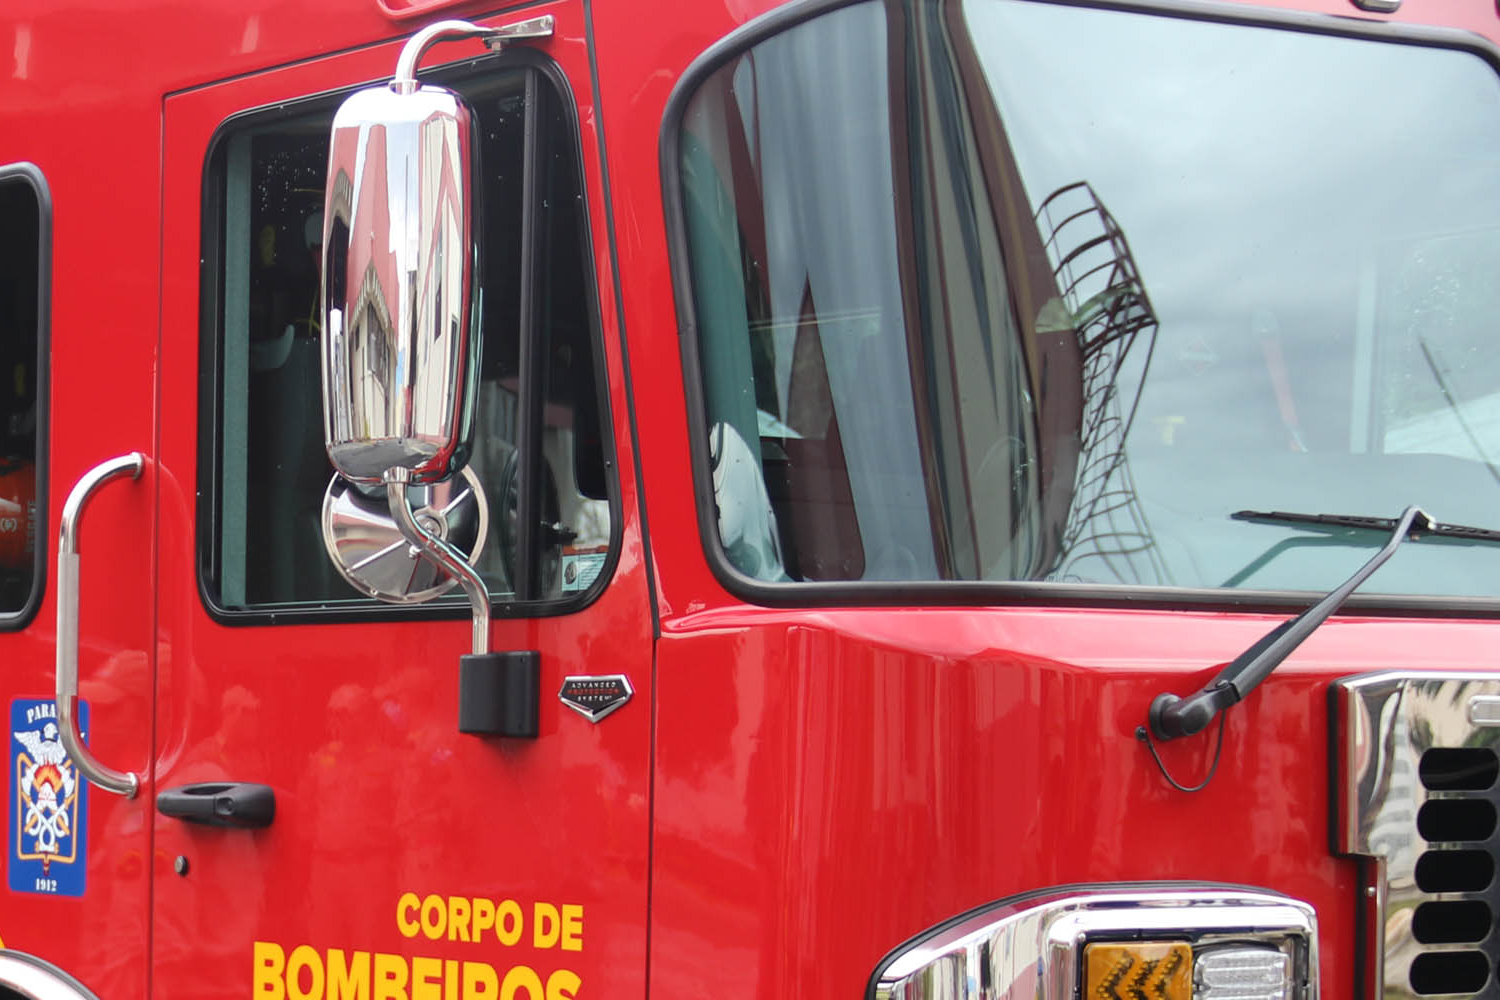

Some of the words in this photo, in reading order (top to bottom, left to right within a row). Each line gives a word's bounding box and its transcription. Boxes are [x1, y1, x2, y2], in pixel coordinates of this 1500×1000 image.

[571, 681, 617, 689] ADVANCED
[35, 877, 58, 892] 1912
[397, 892, 524, 947] CORPO
[534, 902, 584, 951] DE
